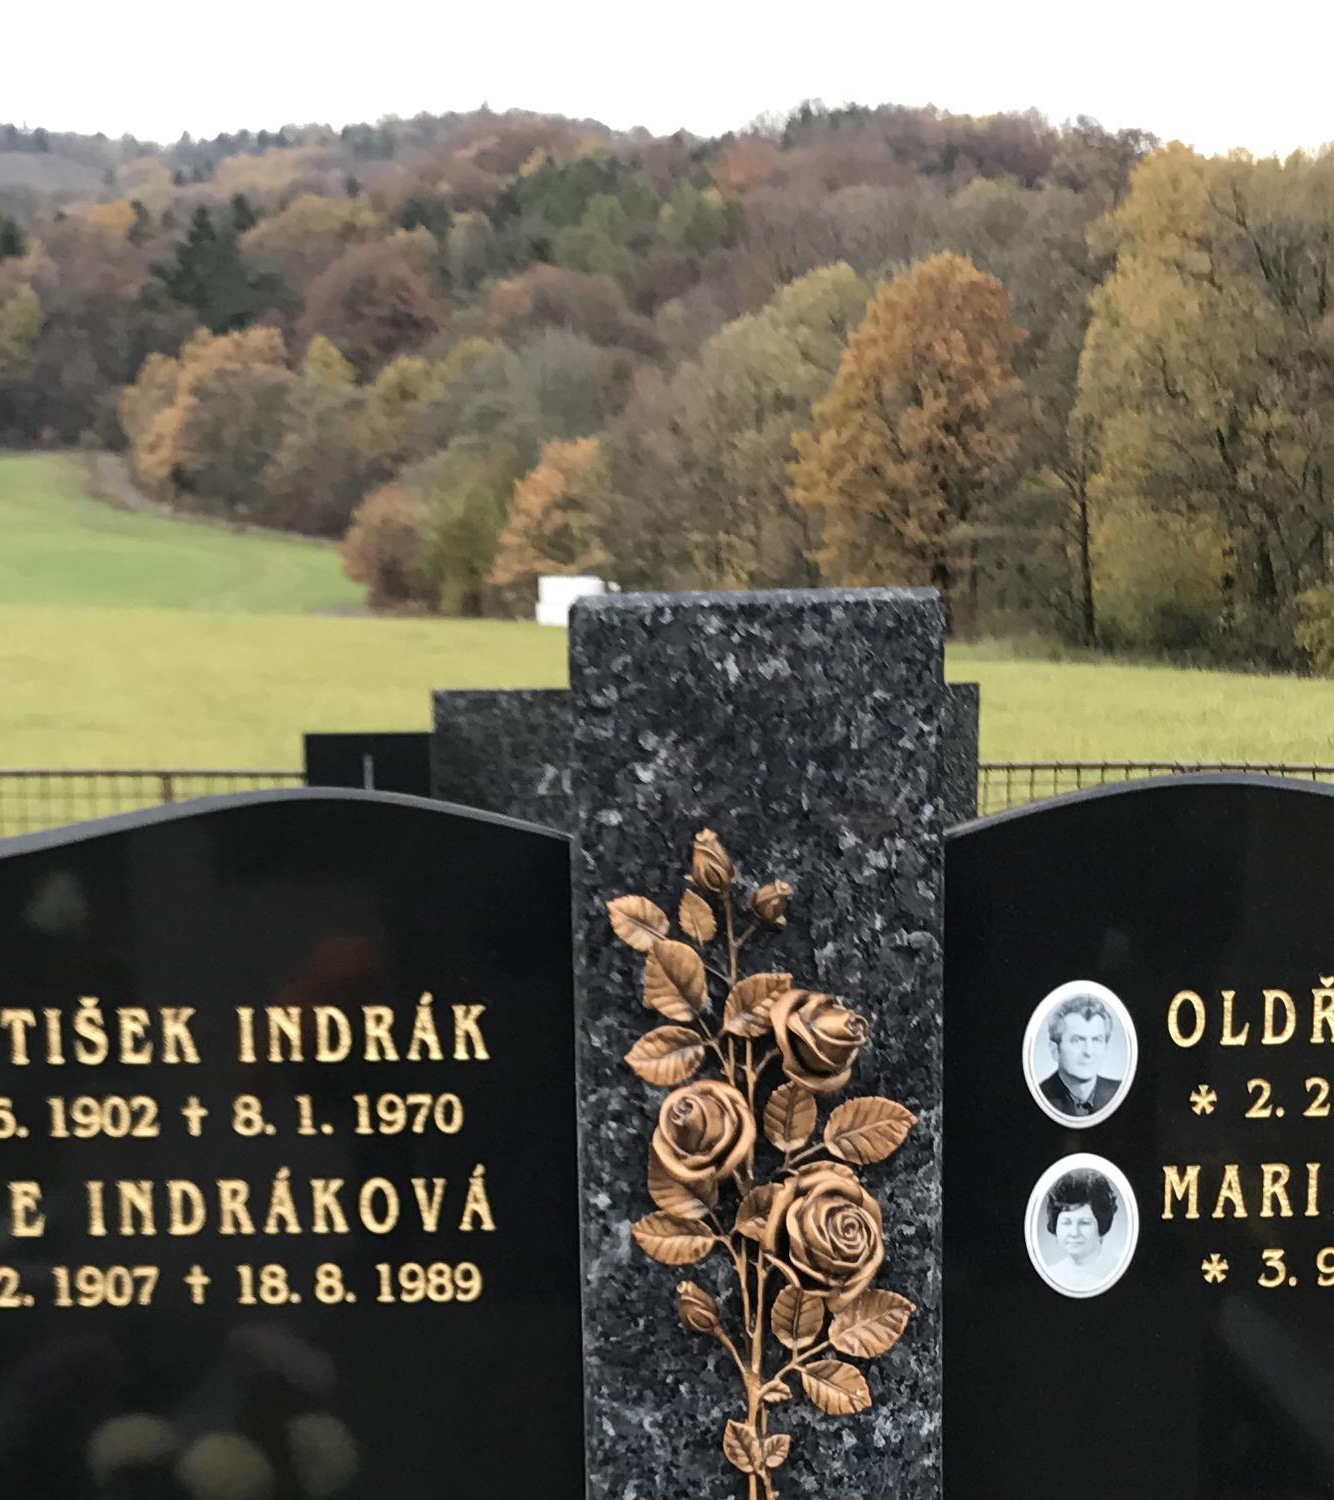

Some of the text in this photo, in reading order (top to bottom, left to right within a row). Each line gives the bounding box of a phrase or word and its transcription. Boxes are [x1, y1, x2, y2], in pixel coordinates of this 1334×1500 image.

[236, 992, 491, 1063] INDRÁK
[46, 1094, 160, 1139] 1902
[353, 1092, 464, 1135] 1970
[85, 1164, 497, 1237] INDRÁKOVÁ
[51, 1265, 160, 1308] 1907
[375, 1261, 483, 1303] 1989
